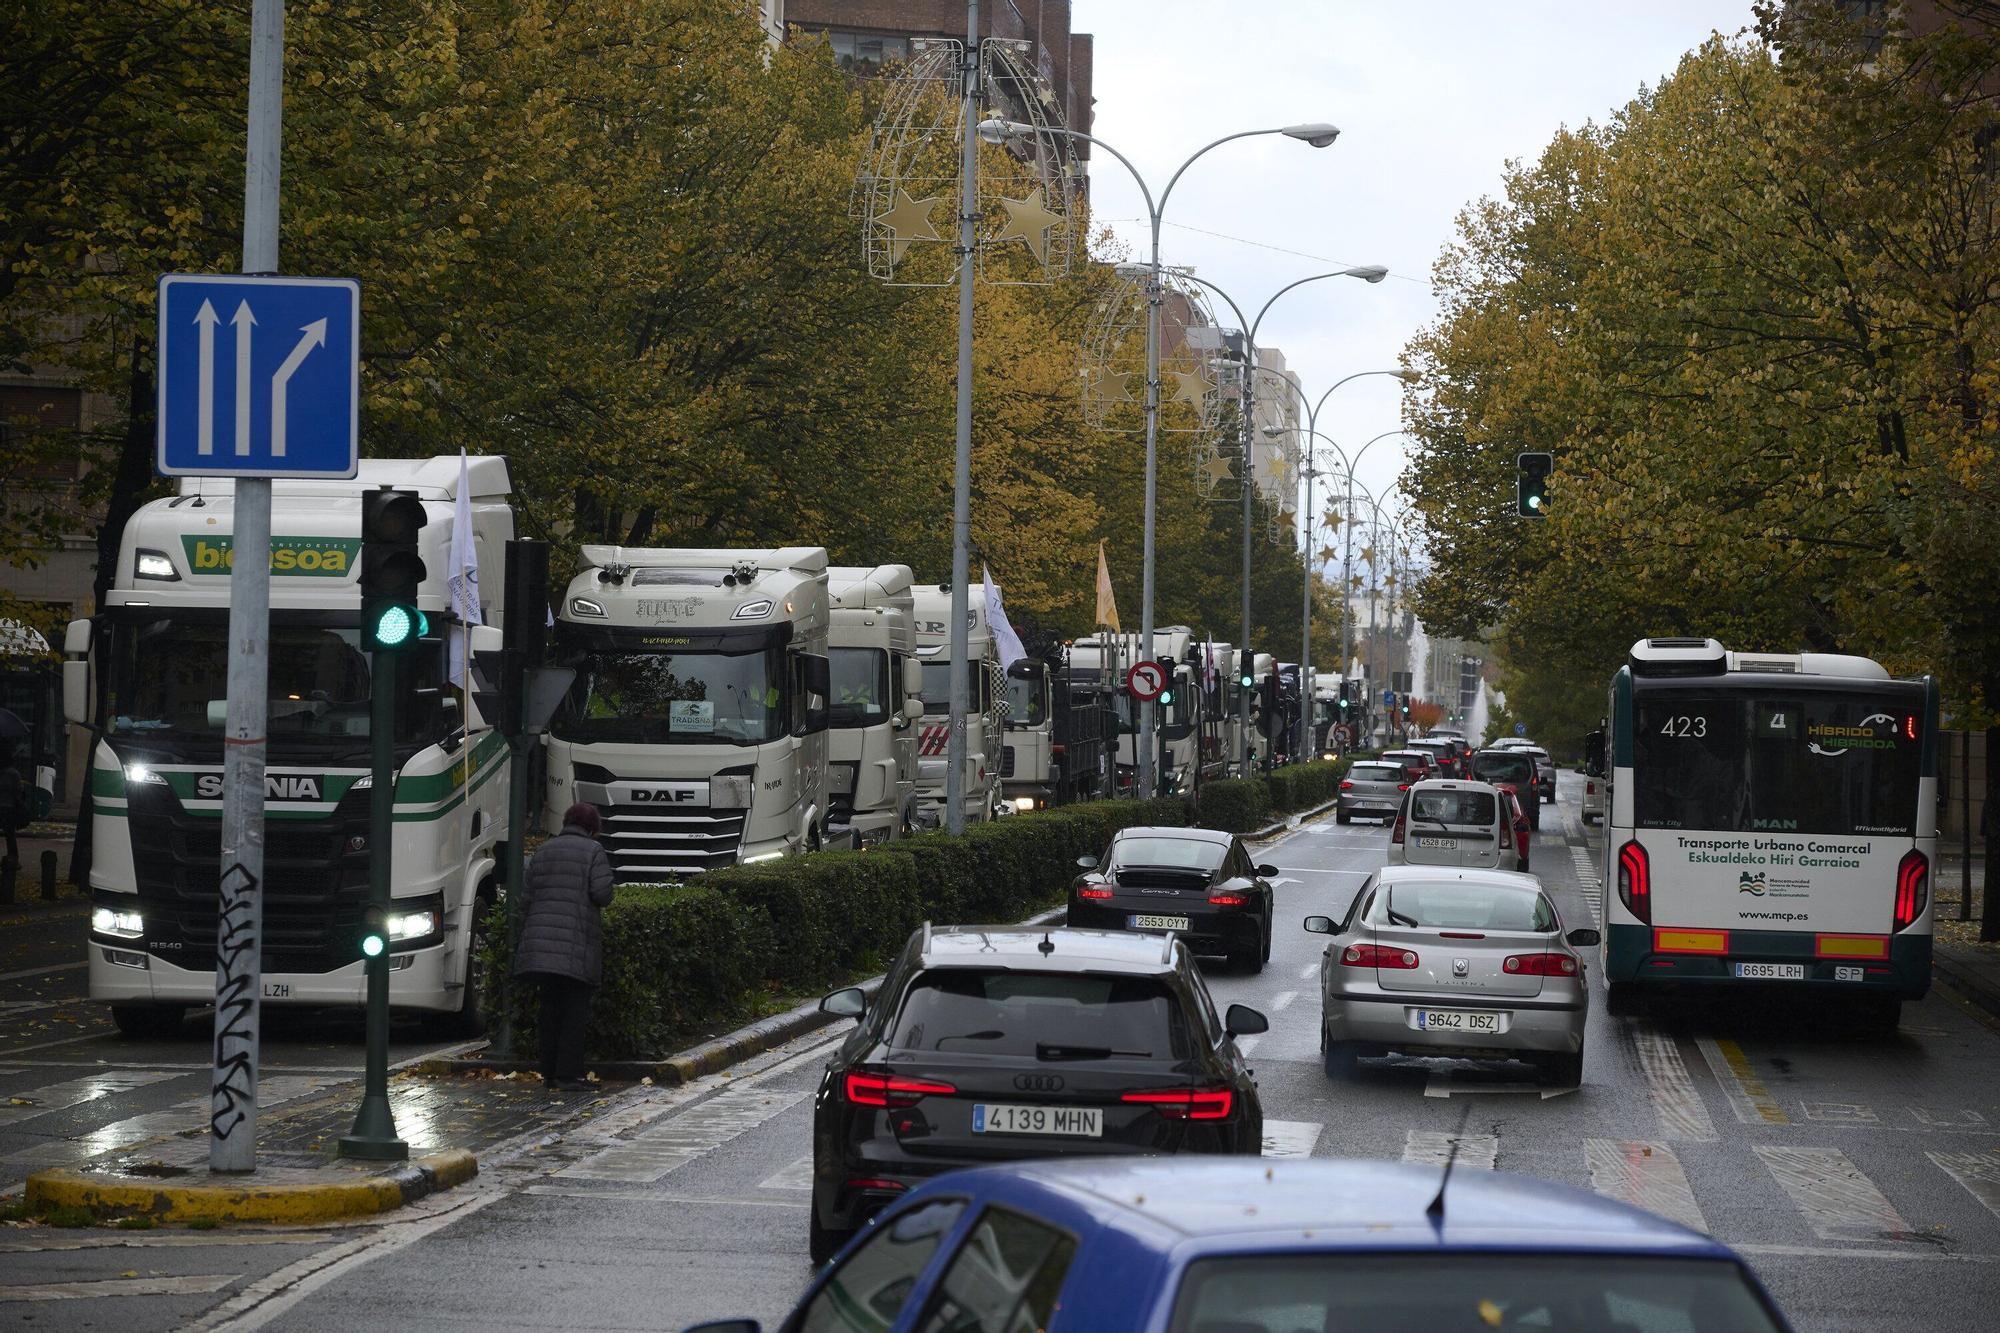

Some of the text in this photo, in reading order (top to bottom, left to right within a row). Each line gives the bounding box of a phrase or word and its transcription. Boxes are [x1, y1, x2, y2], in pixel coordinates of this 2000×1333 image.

[1660, 716, 1708, 738] 423
[1770, 713, 1786, 729] 4
[1808, 724, 1874, 737] HÍBRIDO
[1822, 738, 1897, 749] HIBRIDOA
[197, 775, 320, 799] SNIA
[630, 789, 695, 802] DAF
[1753, 819, 1798, 830] MAN
[1421, 837, 1439, 847] 4528
[1678, 837, 1871, 855] Transporte Urbano Comarcal
[1688, 851, 1860, 868] Eskualdeko Hiri Garraioa
[1137, 916, 1164, 928] 2553
[1739, 911, 1809, 923] www.mcp.es
[1743, 964, 1801, 977] 6695 LRH
[264, 984, 289, 997] LZH
[1428, 1013, 1494, 1029] 9642 DSZ
[989, 1108, 1096, 1133] 4139 MHN
